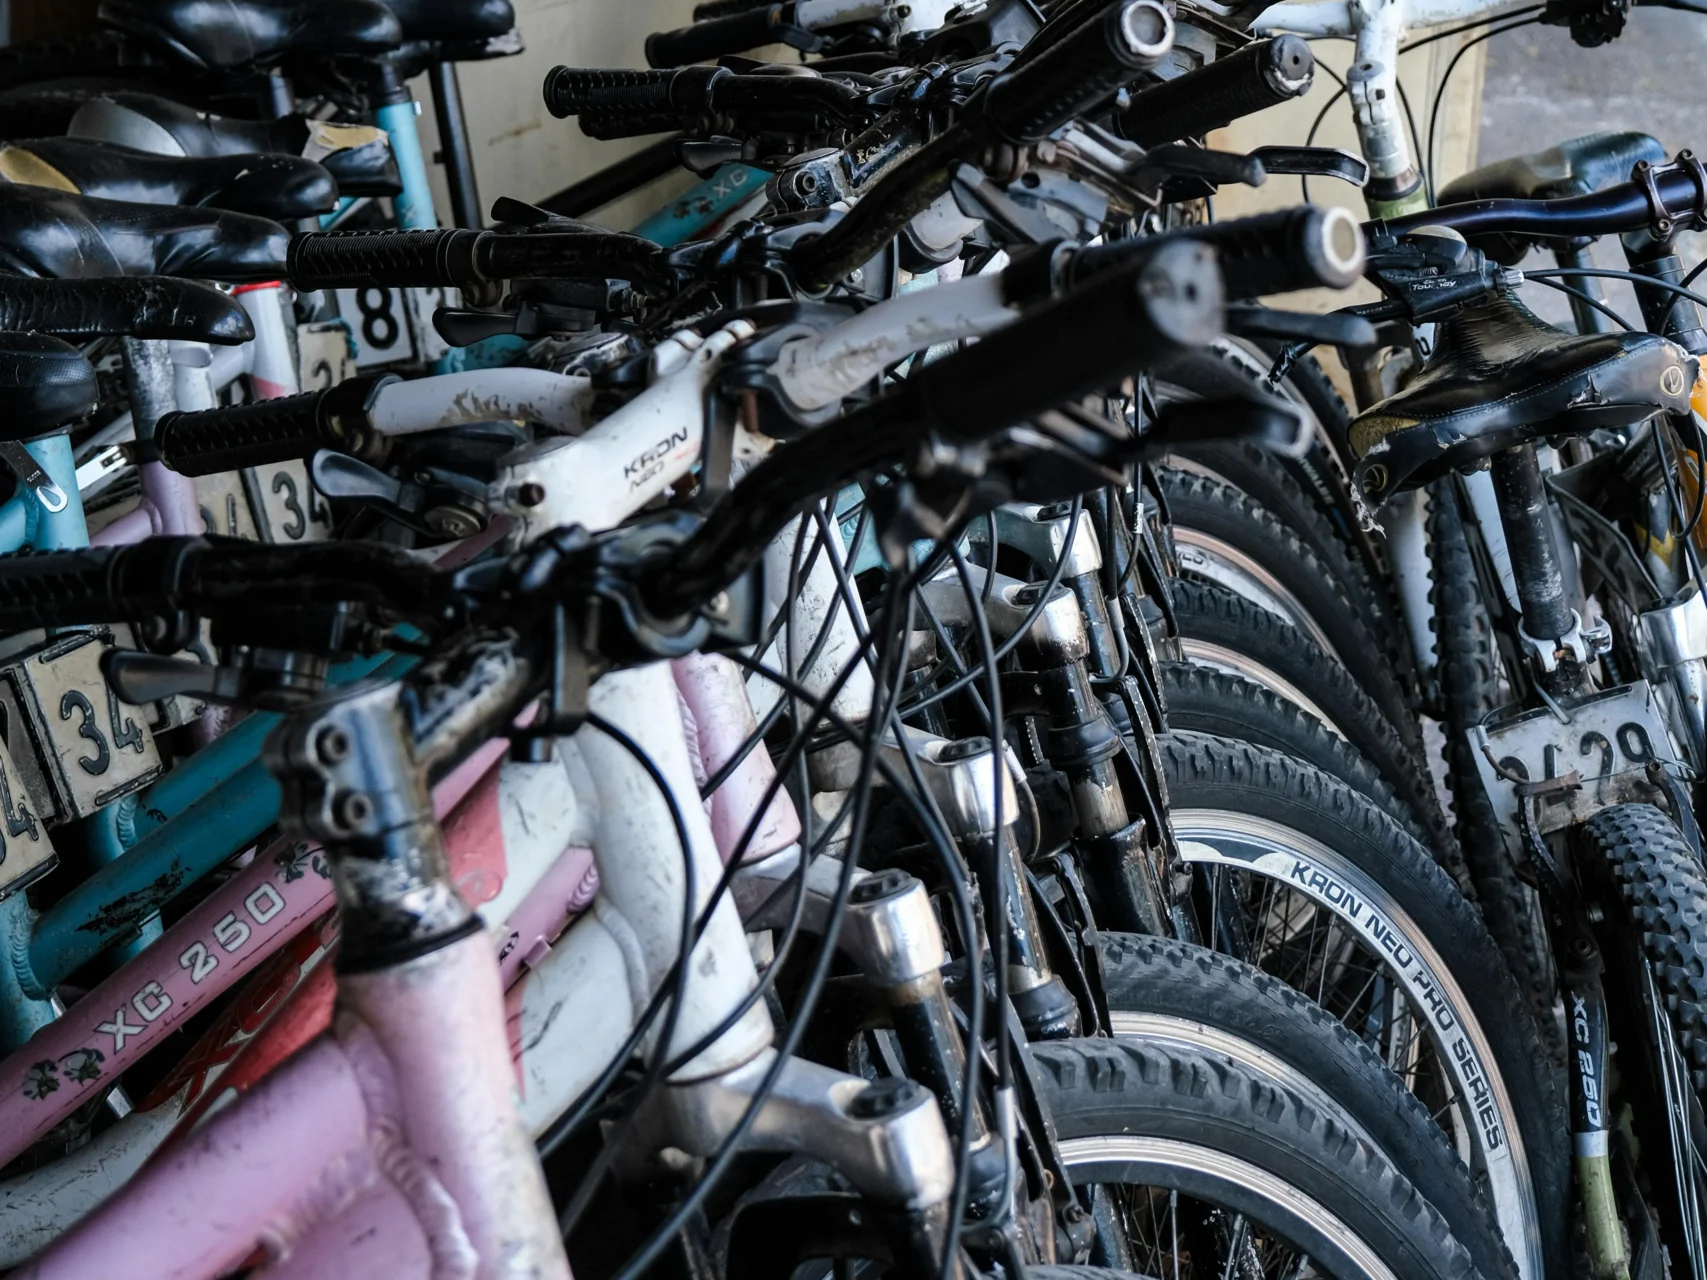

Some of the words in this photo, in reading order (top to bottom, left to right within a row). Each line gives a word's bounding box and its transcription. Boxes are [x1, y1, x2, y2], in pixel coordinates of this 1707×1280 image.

[623, 426, 688, 479] KRON
[1296, 453, 1336, 505] HWALBE
[0, 754, 39, 865] 4
[93, 979, 173, 1056] XC
[178, 881, 286, 985] 250
[1291, 860, 1363, 917] KRON
[1365, 914, 1414, 969] NEO
[1412, 970, 1455, 1032] PRO
[1452, 1037, 1504, 1151] SERIES
[1570, 990, 1590, 1043] XC
[1578, 1051, 1601, 1127] 250
